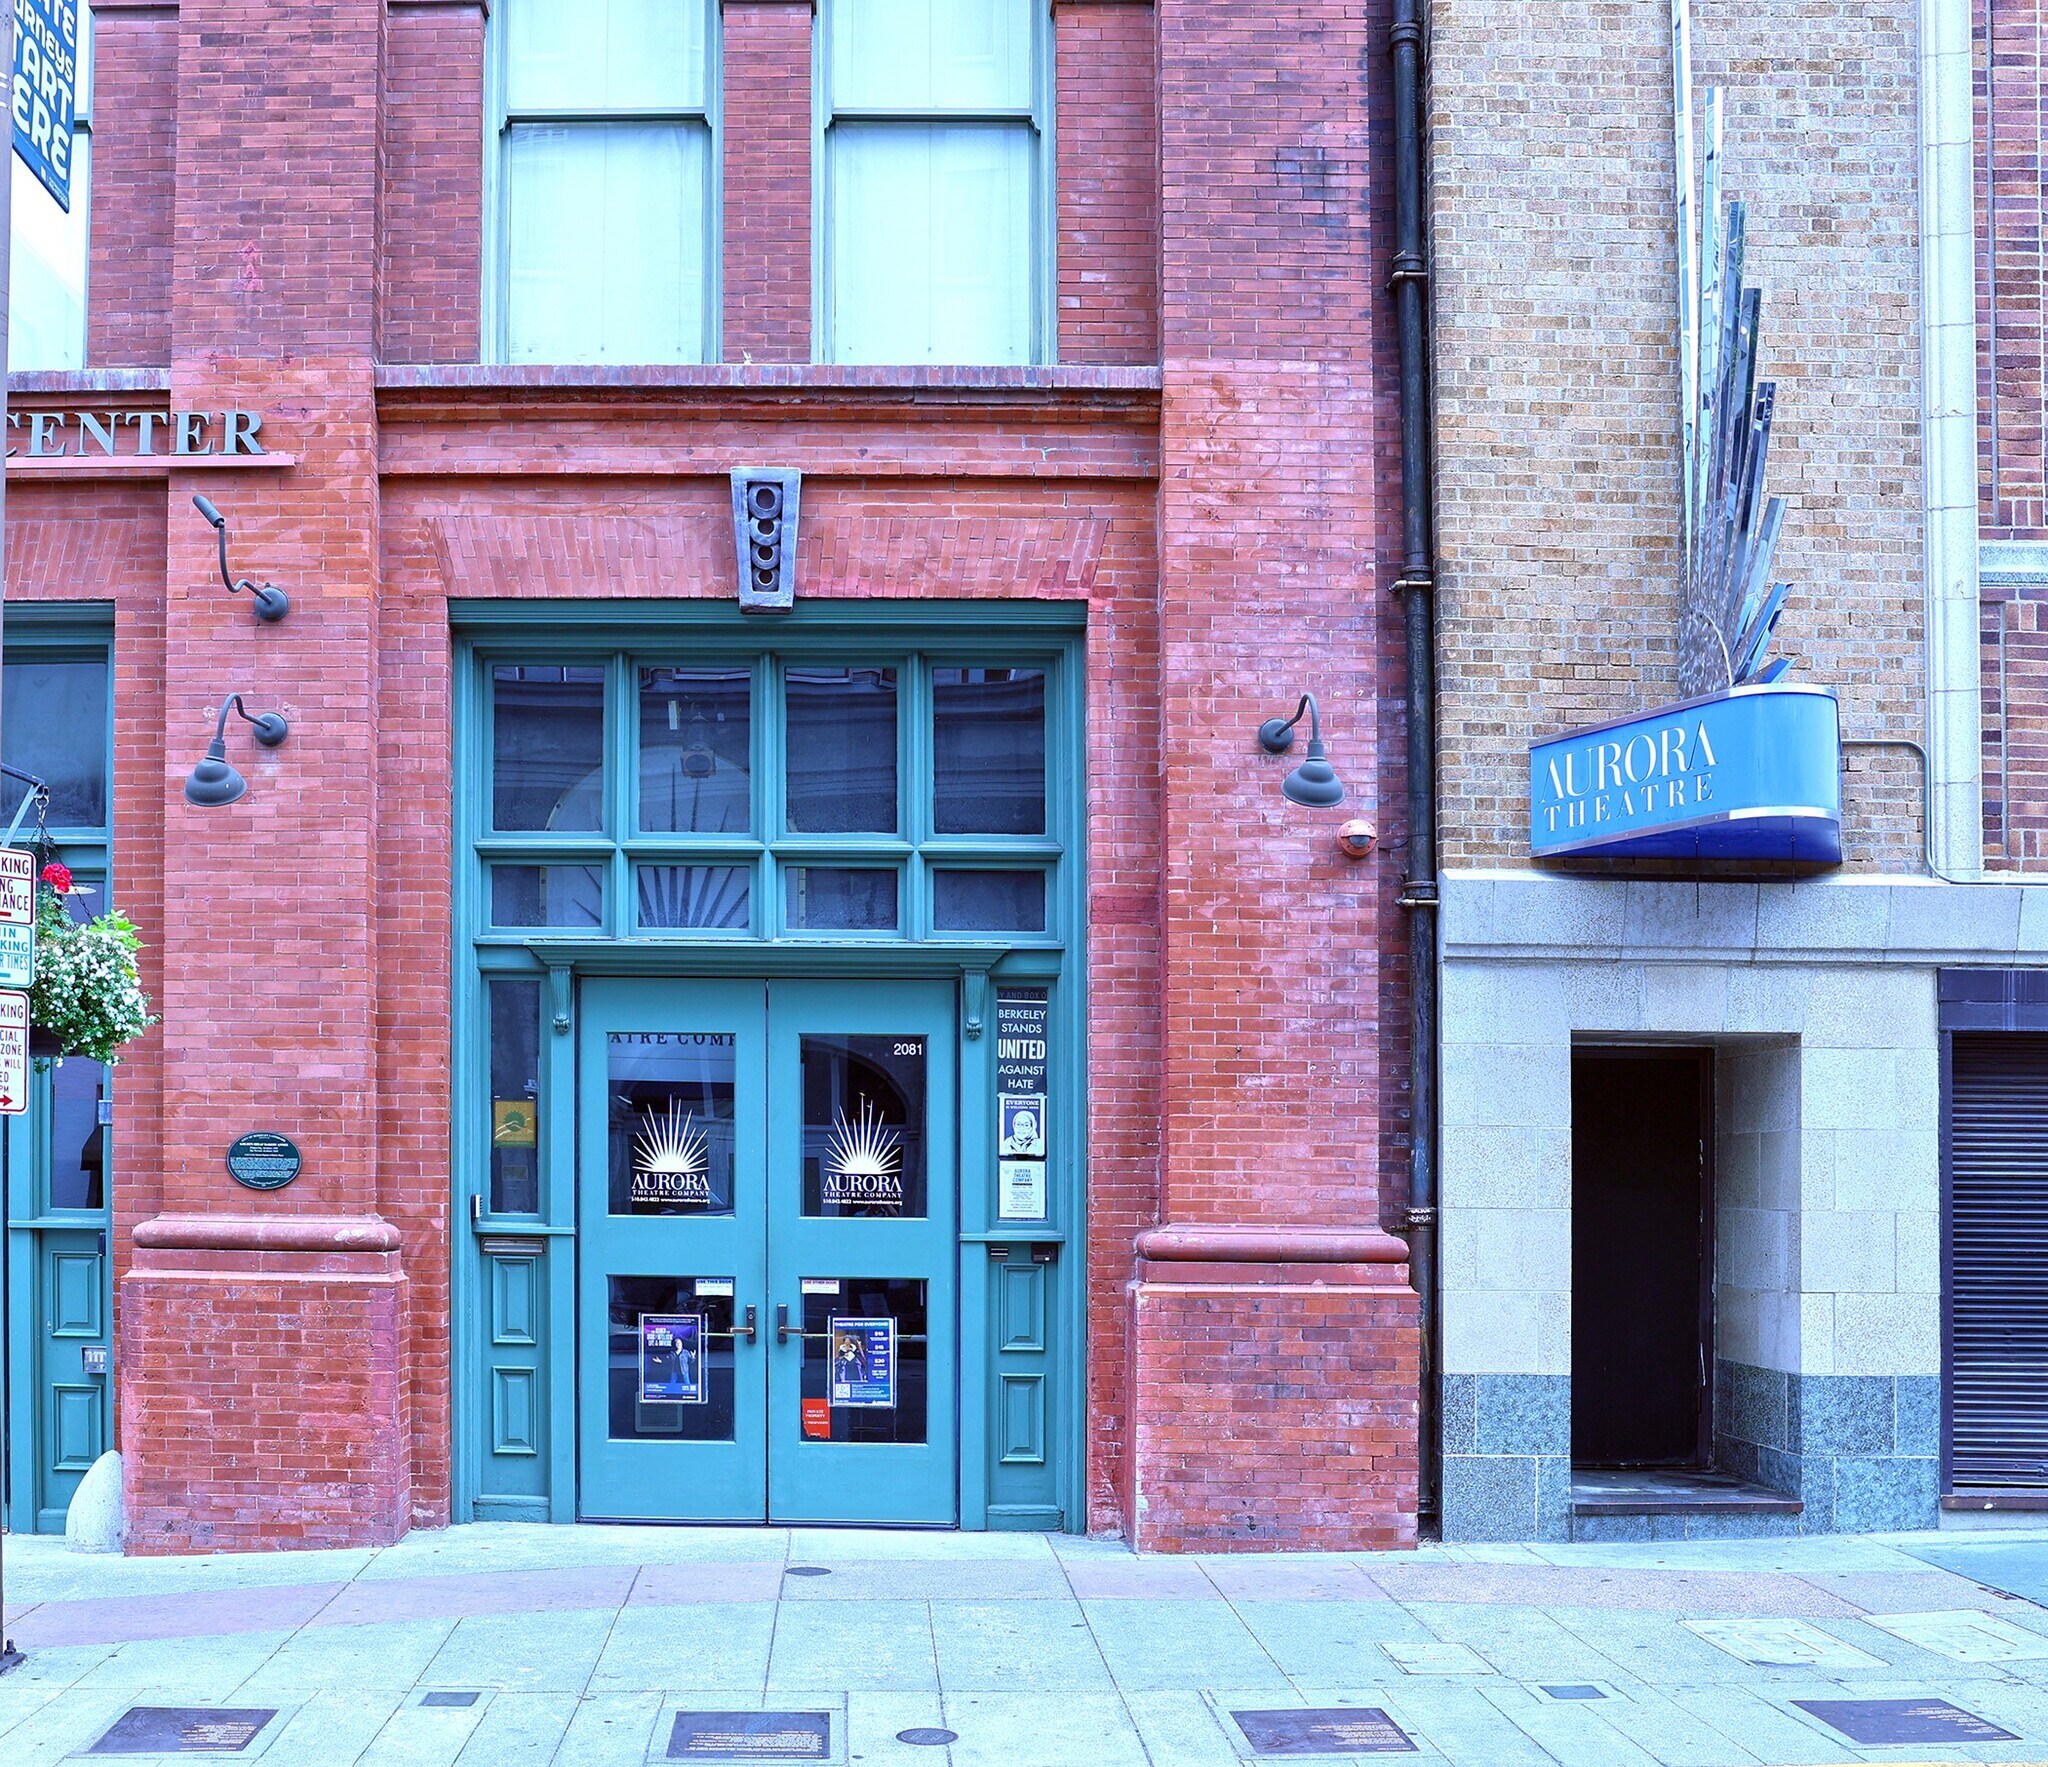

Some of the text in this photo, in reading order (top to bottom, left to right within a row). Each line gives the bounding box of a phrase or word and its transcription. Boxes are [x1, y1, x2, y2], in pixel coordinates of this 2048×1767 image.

[1538, 720, 1718, 804] AURORA
[1544, 773, 1714, 832] THEATRE
[7, 954, 28, 971] TIMES
[998, 1009, 1046, 1020] BERKELEY
[1001, 1023, 1042, 1034] STANDS
[1, 1043, 22, 1056] ZONE
[893, 1043, 923, 1056] 2081
[998, 1039, 1046, 1060] UNITED
[4, 1058, 21, 1069] WILL
[998, 1065, 1045, 1076] AGAINST
[1007, 1079, 1034, 1089] HATE
[631, 1173, 710, 1190] AURORA
[823, 1175, 903, 1192] AURORA
[671, 1189, 710, 1197] COMPANY
[863, 1191, 902, 1199] COMPANY
